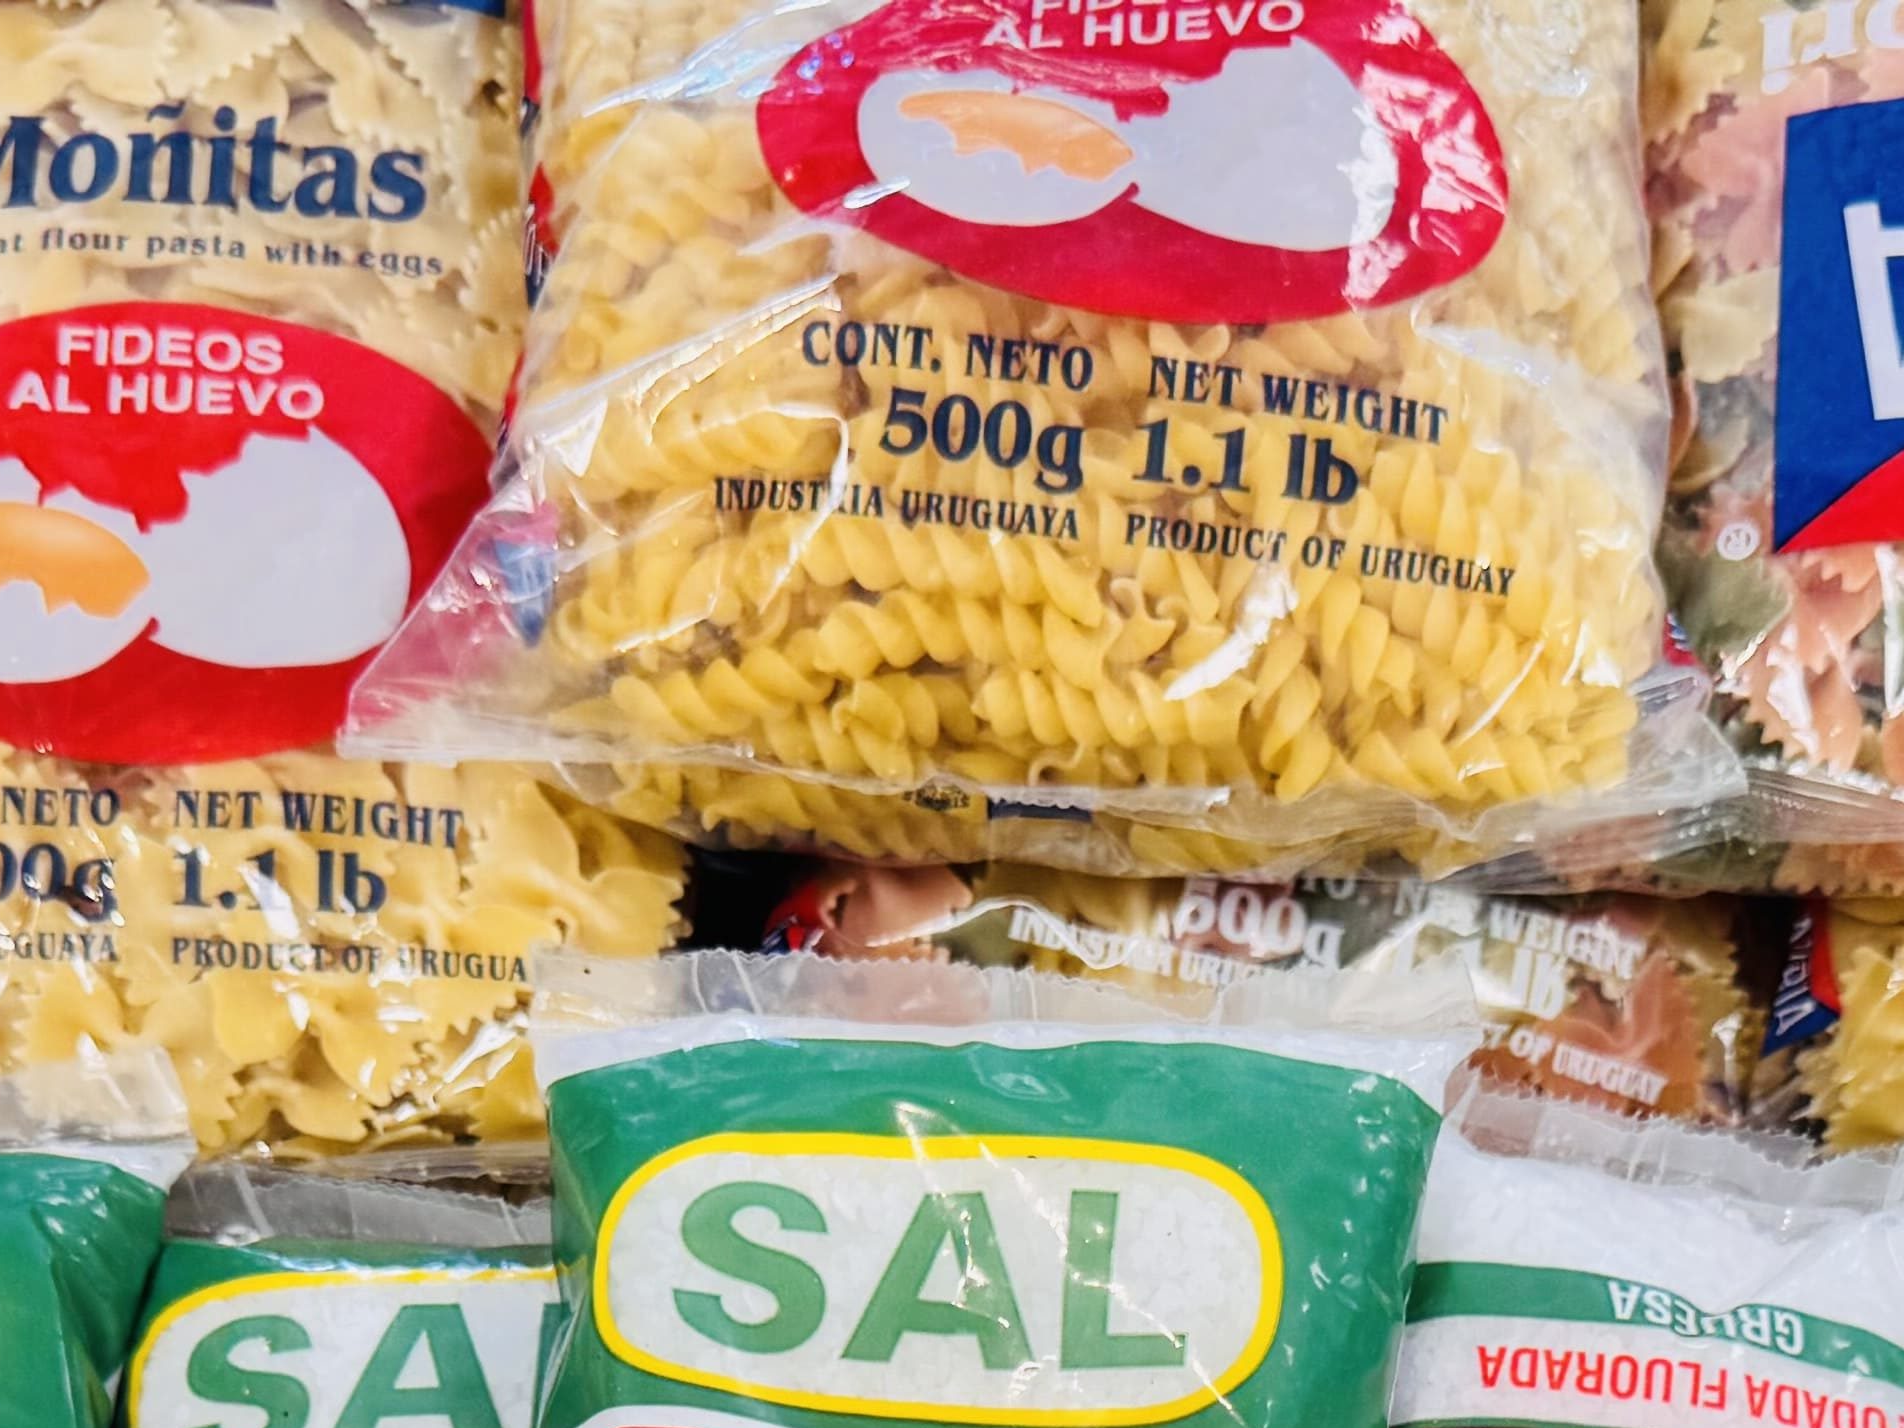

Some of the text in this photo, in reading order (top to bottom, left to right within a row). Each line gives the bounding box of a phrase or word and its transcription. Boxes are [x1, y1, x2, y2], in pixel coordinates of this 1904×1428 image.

[982, 0, 1304, 50] AL HUEVO
[41, 227, 129, 254] flour
[146, 233, 247, 263] pasta
[264, 242, 341, 269] with
[358, 248, 445, 280] eggs
[56, 323, 285, 375] FIDEOS
[6, 371, 325, 422] AL HUEVO
[801, 318, 1450, 448] CONT. NETO NET WEIGHT
[877, 388, 1360, 508] 500g 1.1 lb
[712, 475, 1518, 598] INDUSTRIA URUGUAYA PRODUCT OF URUGUAY
[1, 787, 121, 829] NETO
[173, 790, 264, 830] NET
[281, 793, 465, 851] WEIGHT
[173, 845, 282, 911] 1.1
[315, 850, 388, 915] lb
[172, 935, 327, 974] PRODUCT
[341, 943, 383, 976] OF
[671, 1180, 1190, 1373] SAL
[1607, 1279, 1806, 1357] GRUESA
[1476, 1344, 1727, 1411] FLUORADA
